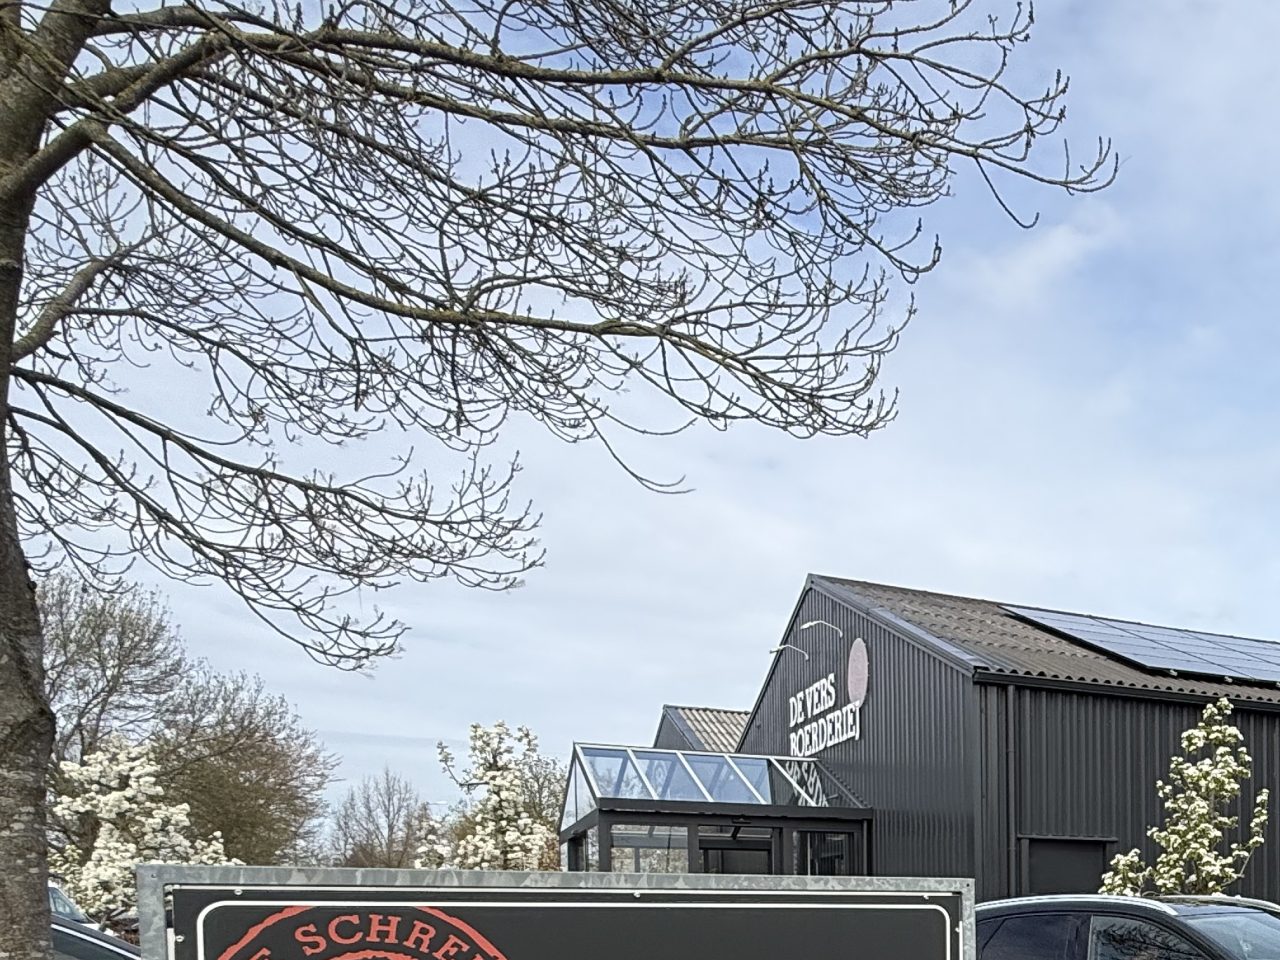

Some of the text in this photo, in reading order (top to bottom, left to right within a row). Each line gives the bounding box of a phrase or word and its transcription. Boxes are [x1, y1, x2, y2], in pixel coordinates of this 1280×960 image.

[789, 672, 836, 728] DE VERS
[790, 699, 860, 757] BOERDERIEJ
